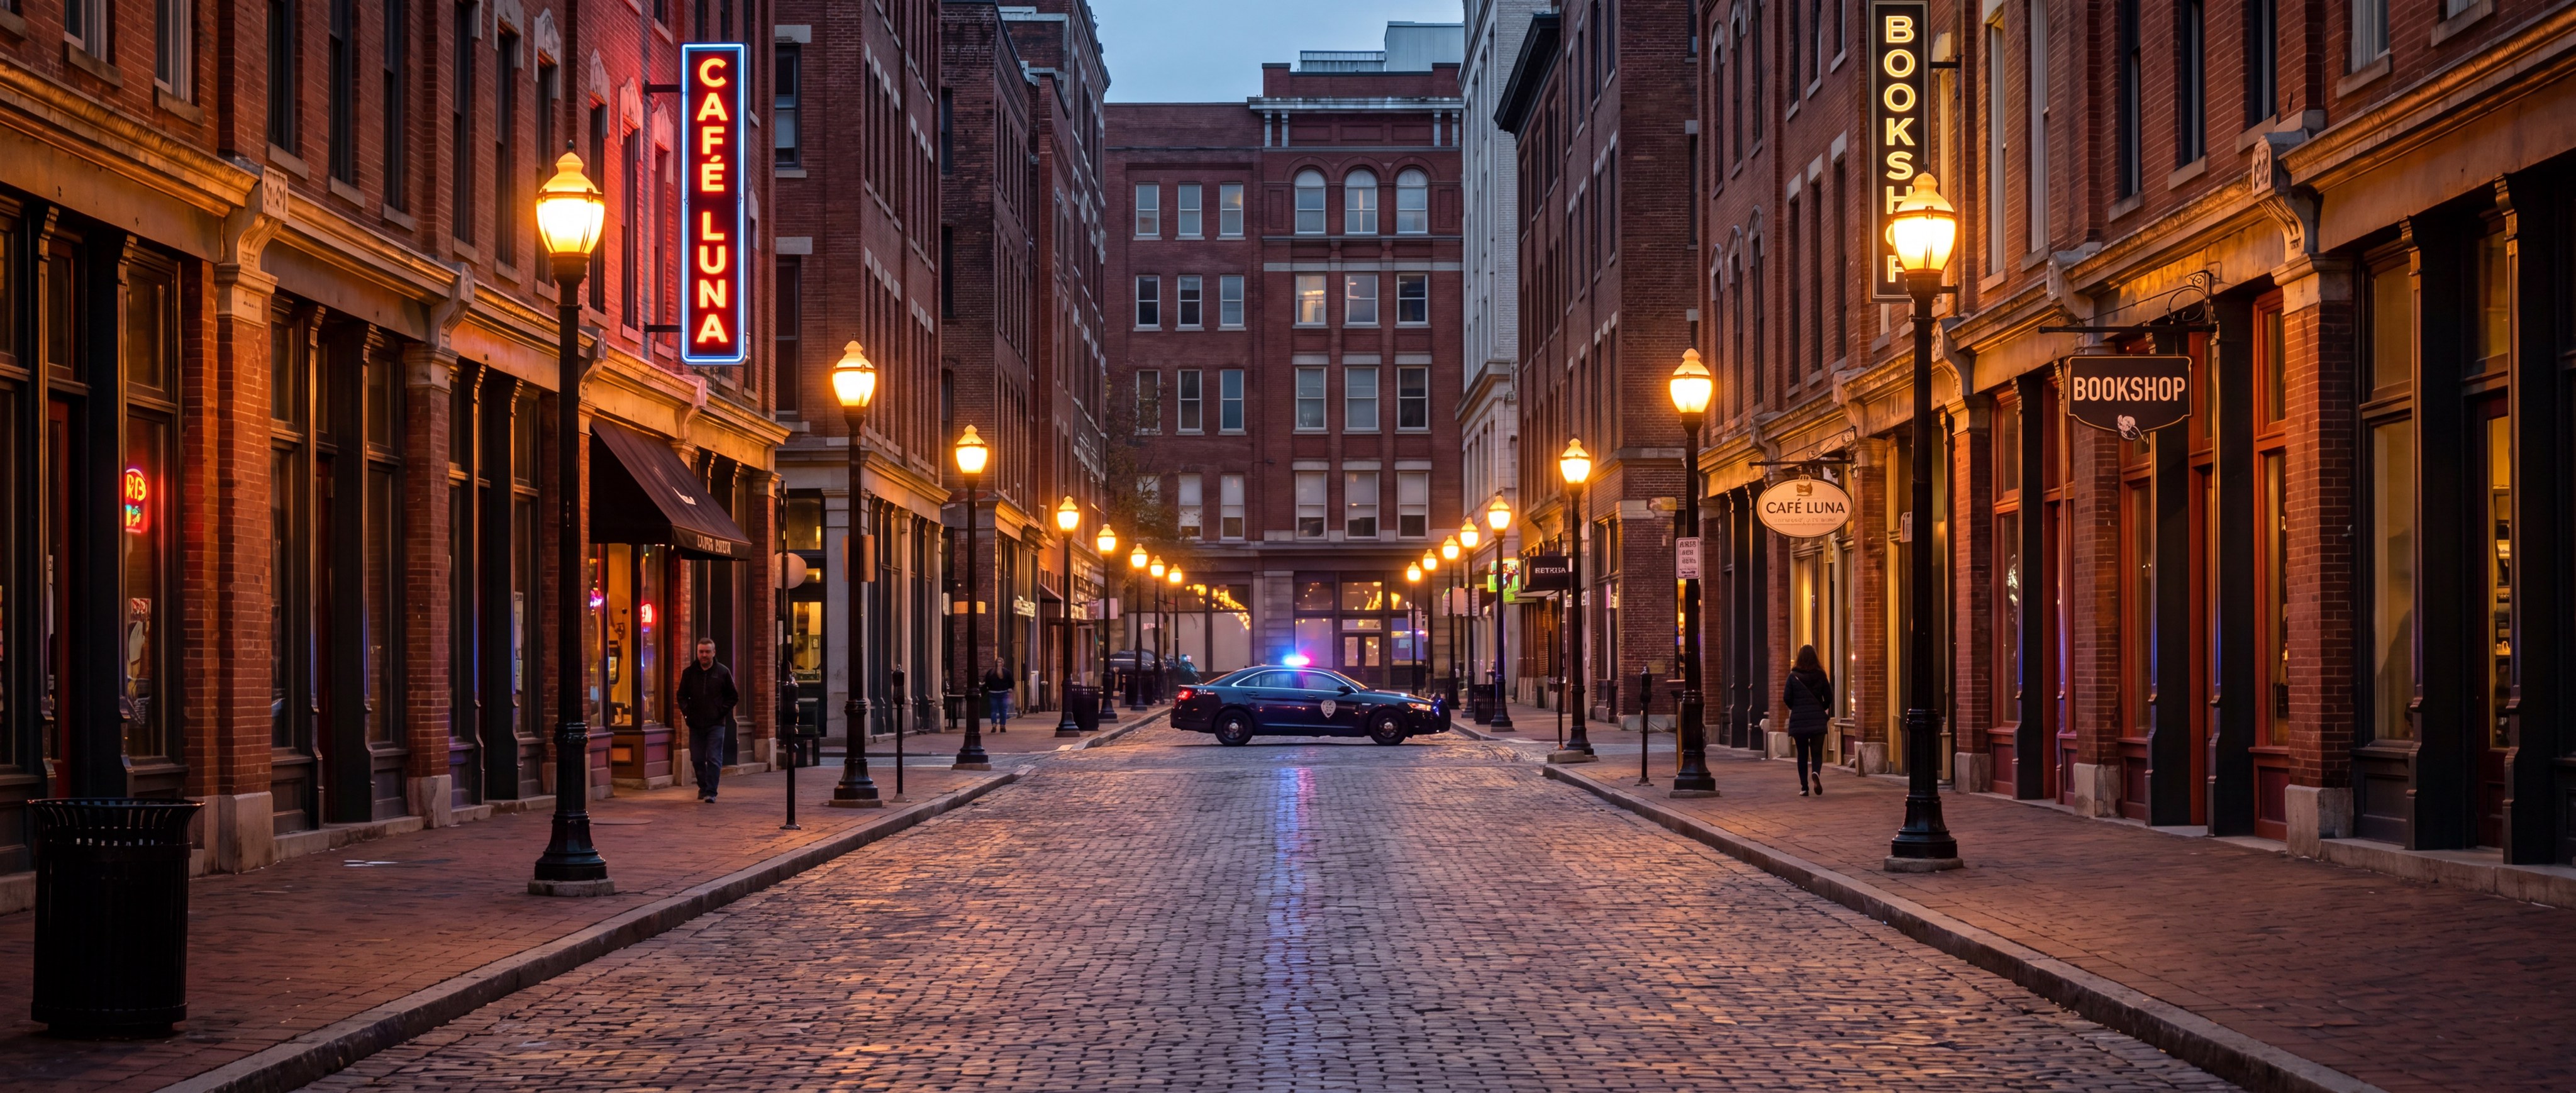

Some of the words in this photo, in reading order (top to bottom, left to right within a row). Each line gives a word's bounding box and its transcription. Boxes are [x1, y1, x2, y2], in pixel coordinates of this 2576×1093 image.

[696, 57, 729, 192] CAFÉ
[1883, 15, 1916, 283] BOOKSHP
[696, 211, 729, 343] LUNA
[2074, 376, 2185, 402] BOOKSHOP
[1766, 497, 1802, 514] CAFÉ
[1806, 501, 1845, 514] LUNA
